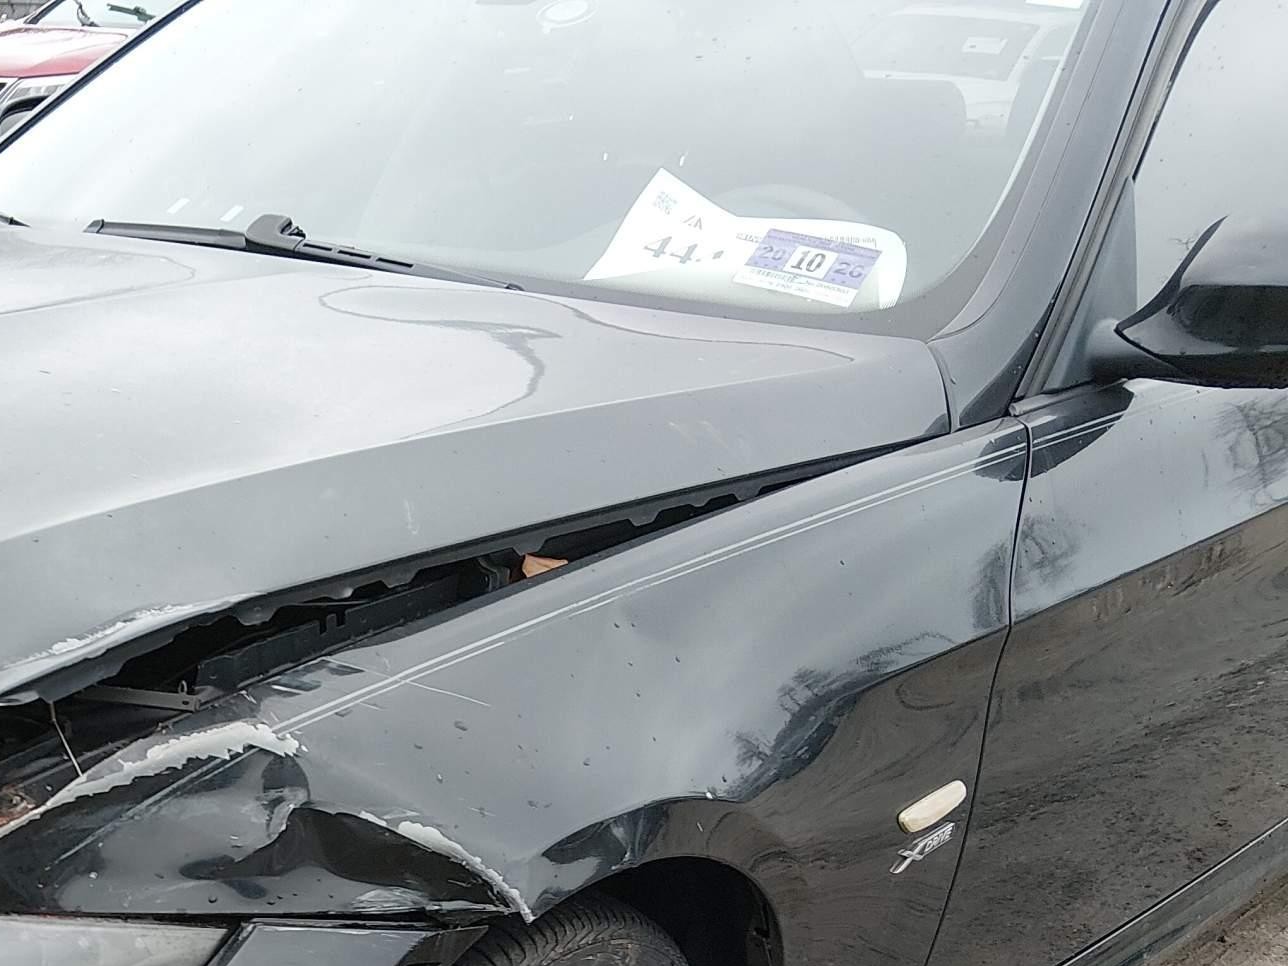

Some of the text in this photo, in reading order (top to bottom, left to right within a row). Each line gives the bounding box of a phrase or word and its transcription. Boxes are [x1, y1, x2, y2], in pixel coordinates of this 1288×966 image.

[759, 245, 865, 279] 20 10 26
